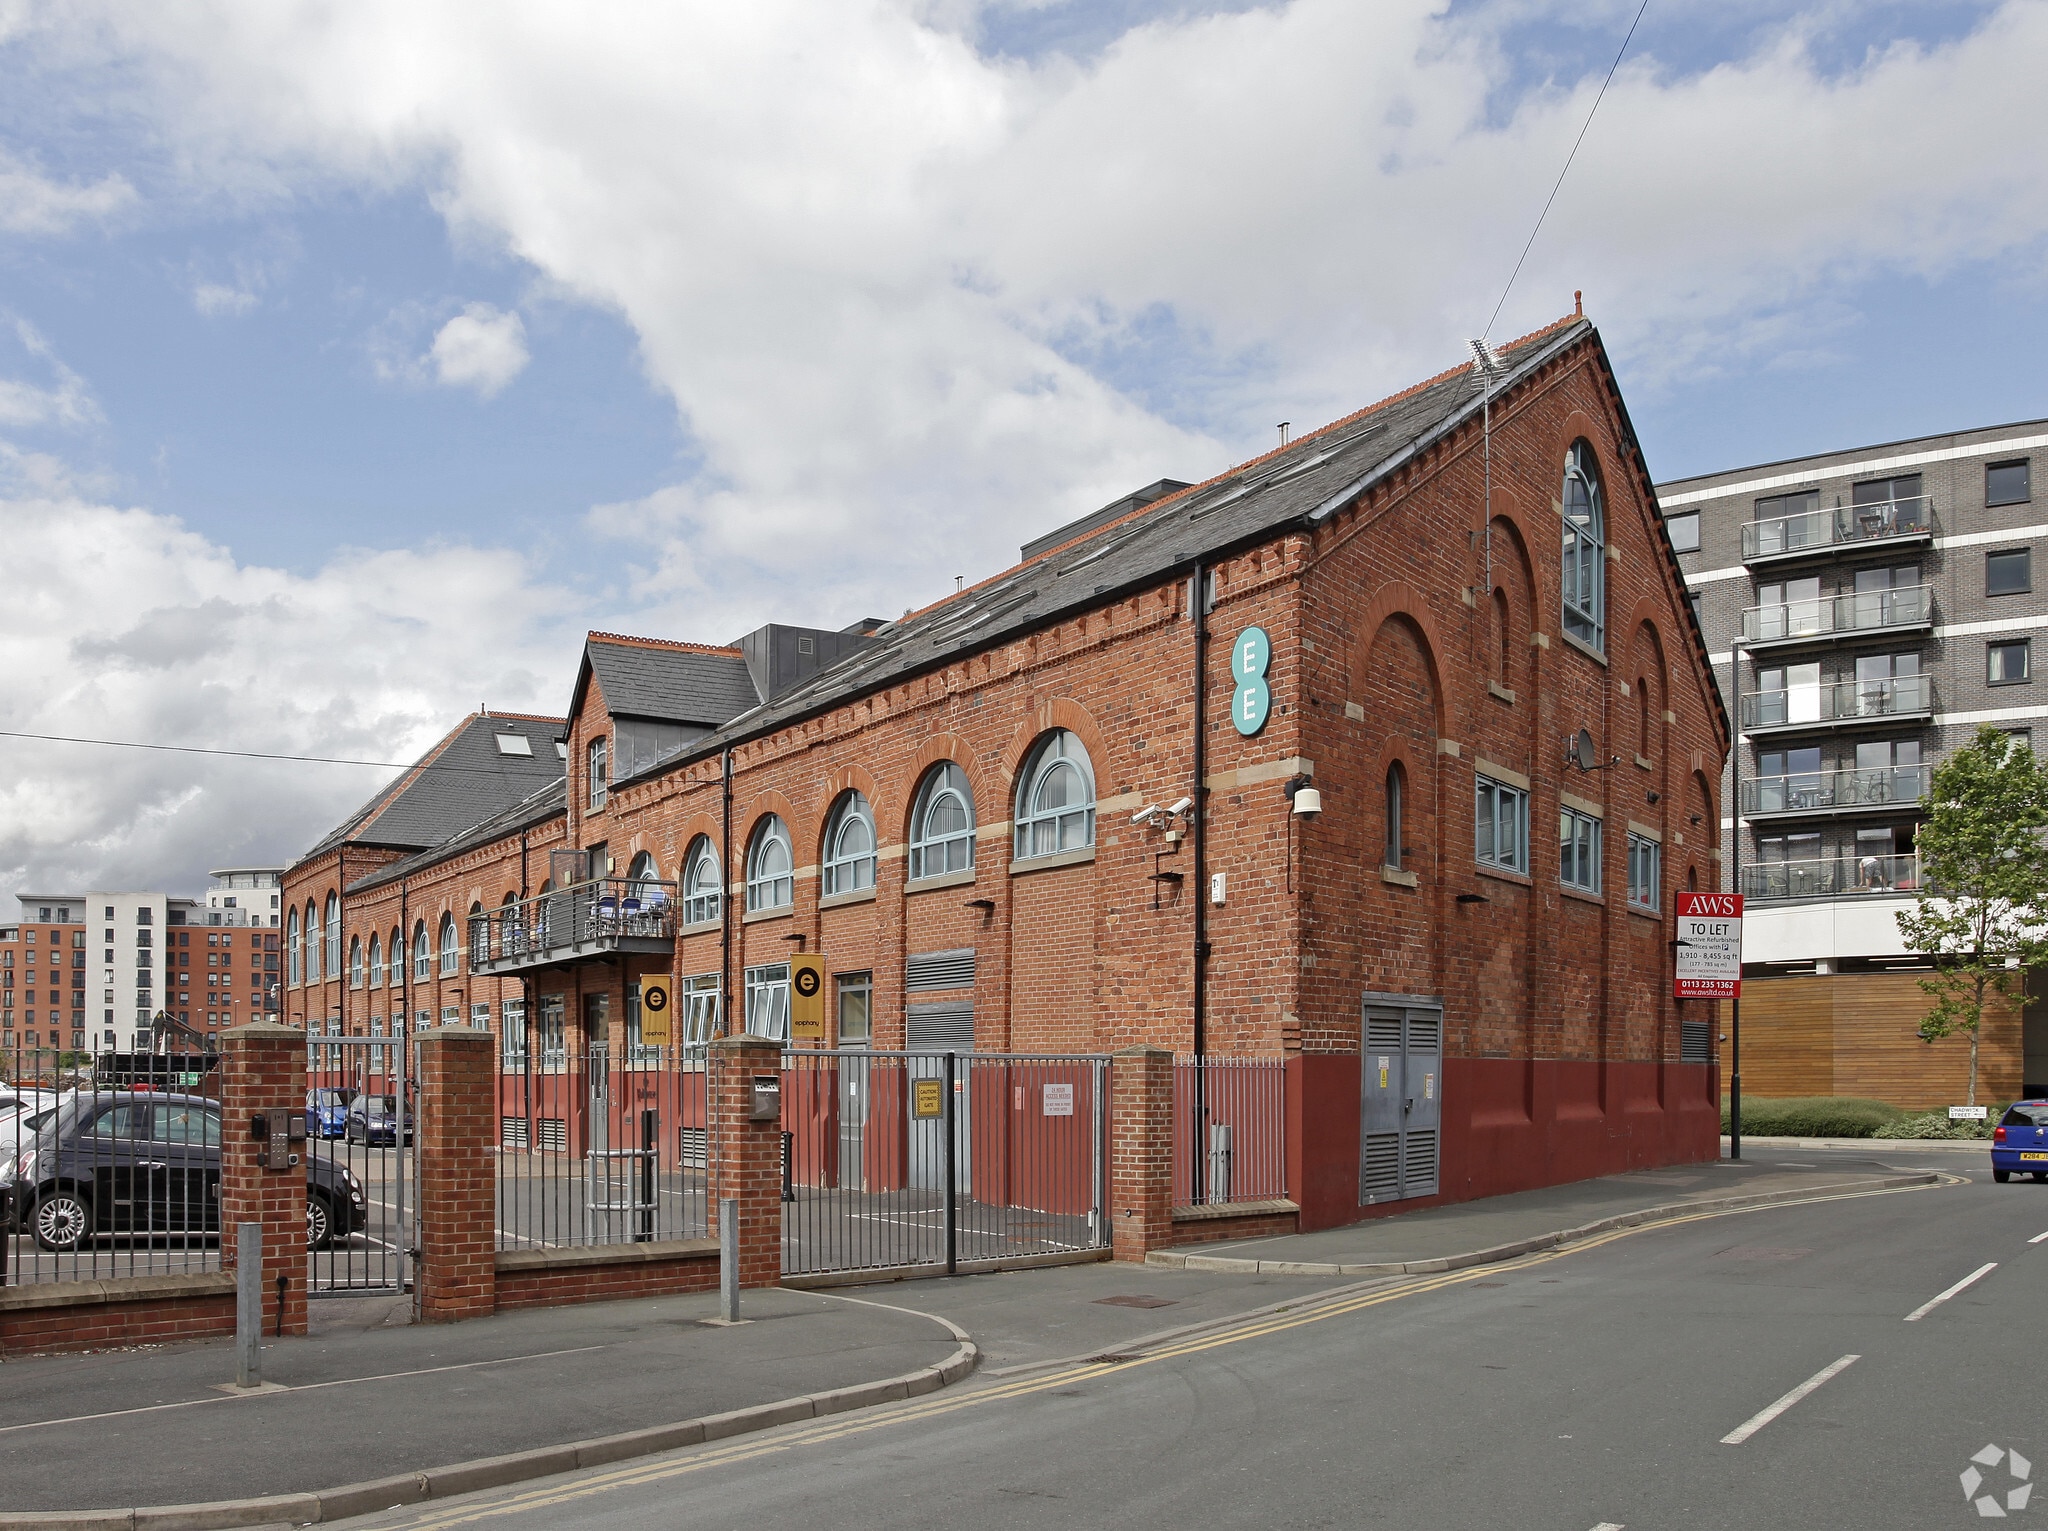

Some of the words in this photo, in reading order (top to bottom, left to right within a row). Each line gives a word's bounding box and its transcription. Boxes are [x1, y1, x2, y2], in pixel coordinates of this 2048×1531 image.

[1686, 896, 1734, 914] AWS
[1690, 923, 1706, 934] TO
[1710, 924, 1729, 935] LET
